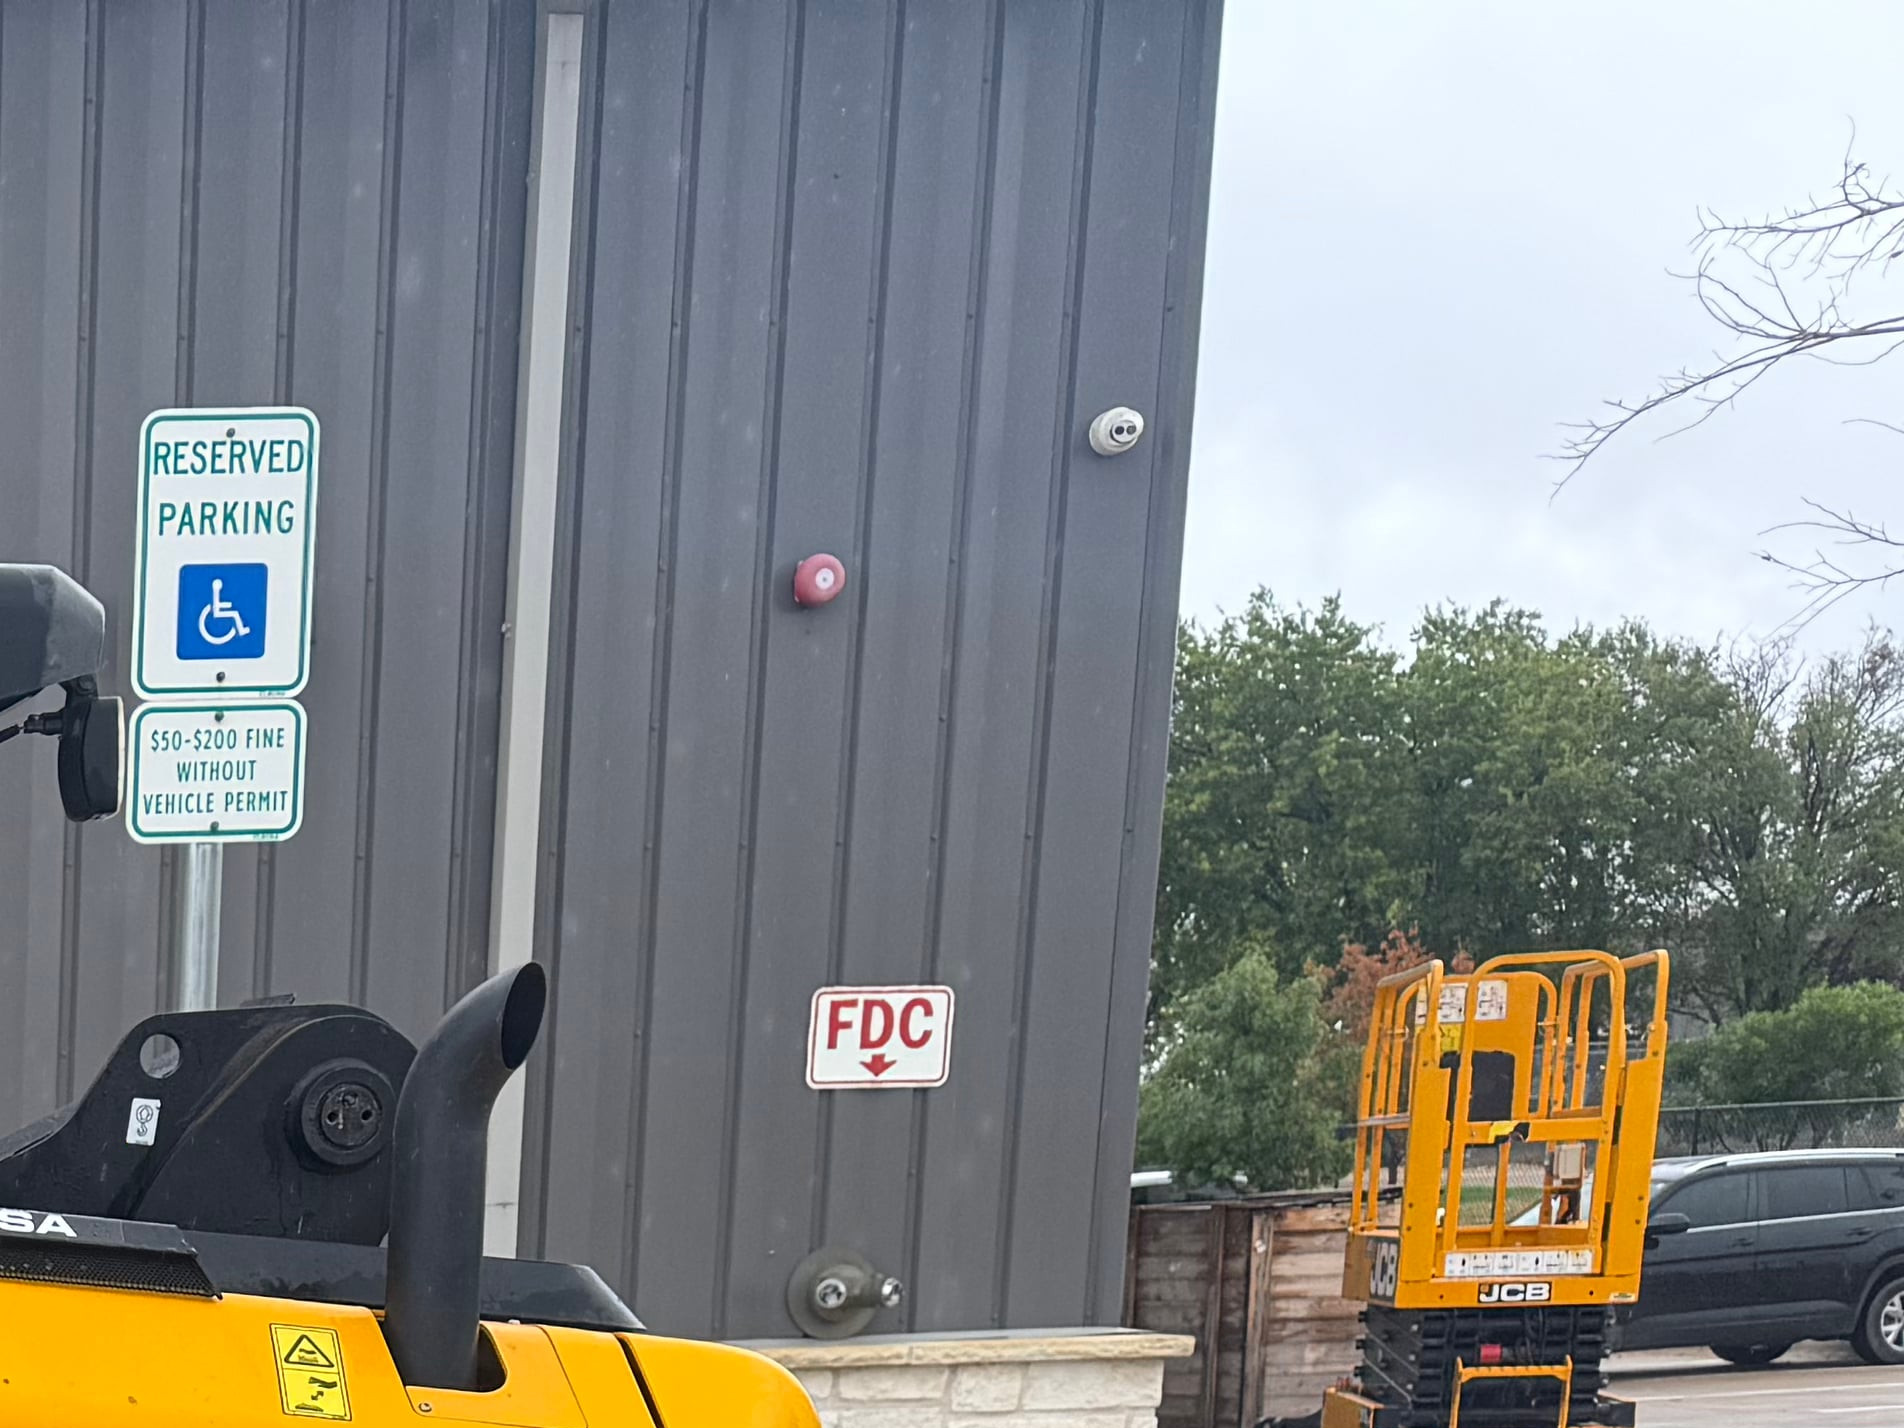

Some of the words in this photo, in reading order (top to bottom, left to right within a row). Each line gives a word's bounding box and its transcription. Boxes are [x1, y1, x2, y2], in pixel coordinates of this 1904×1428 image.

[153, 439, 304, 475] RESERVED
[158, 500, 294, 536] PARKING
[151, 729, 237, 753] $50-$200
[246, 727, 285, 749] FINE
[177, 760, 256, 783] WITHOUT
[143, 791, 215, 816] VEHICLE
[224, 790, 288, 813] PERMIT
[827, 998, 933, 1049] FDC
[1480, 1283, 1550, 1302] JCB
